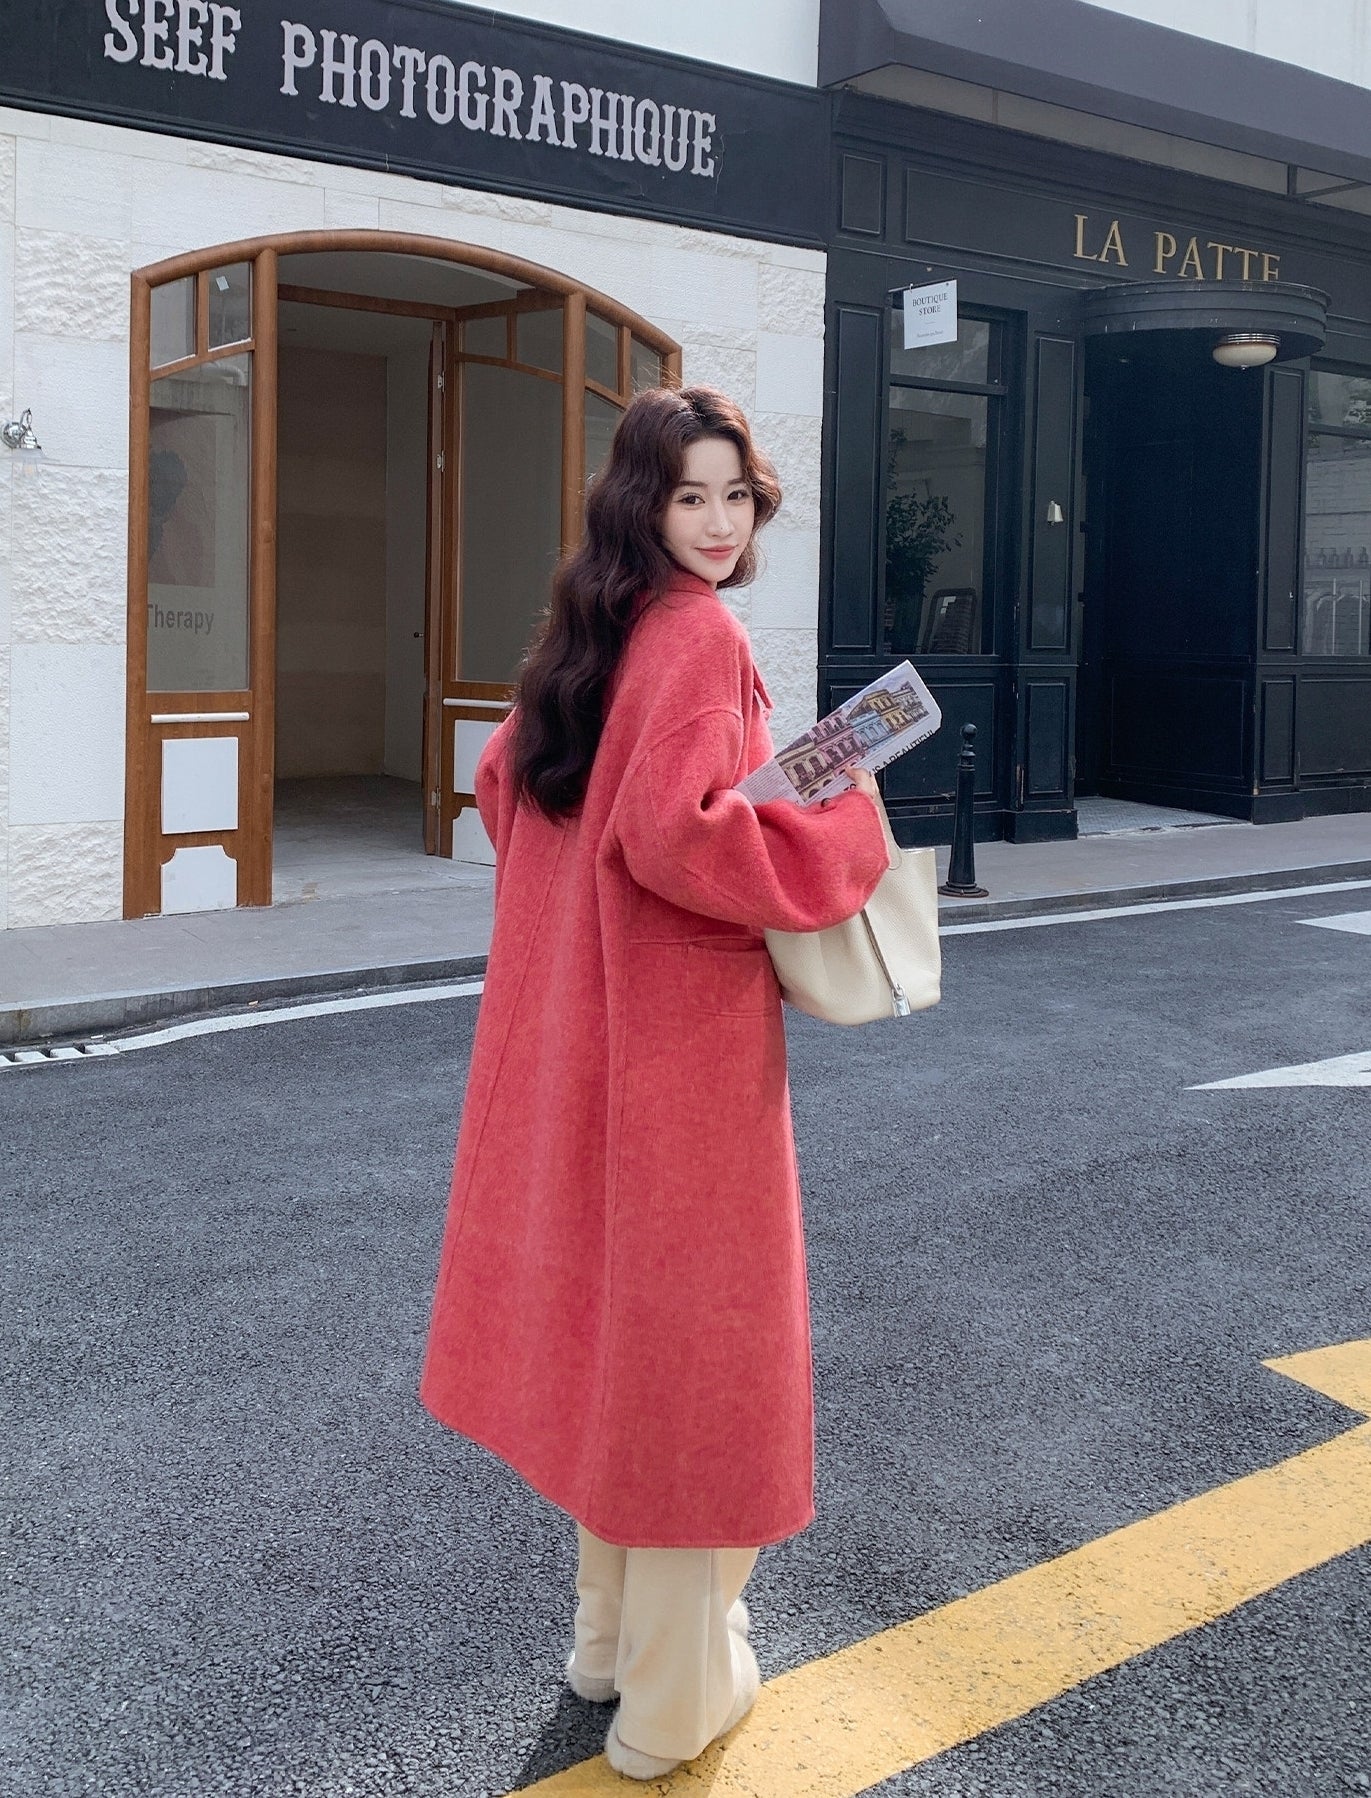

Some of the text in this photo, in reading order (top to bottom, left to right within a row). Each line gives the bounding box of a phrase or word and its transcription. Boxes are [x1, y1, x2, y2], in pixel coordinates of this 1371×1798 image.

[104, 0, 716, 178] SEEF PHOTOGRAPHIQUE
[1074, 214, 1280, 281] LA PATTE
[912, 293, 948, 307] BOUTIQUE
[919, 305, 941, 316] STORE
